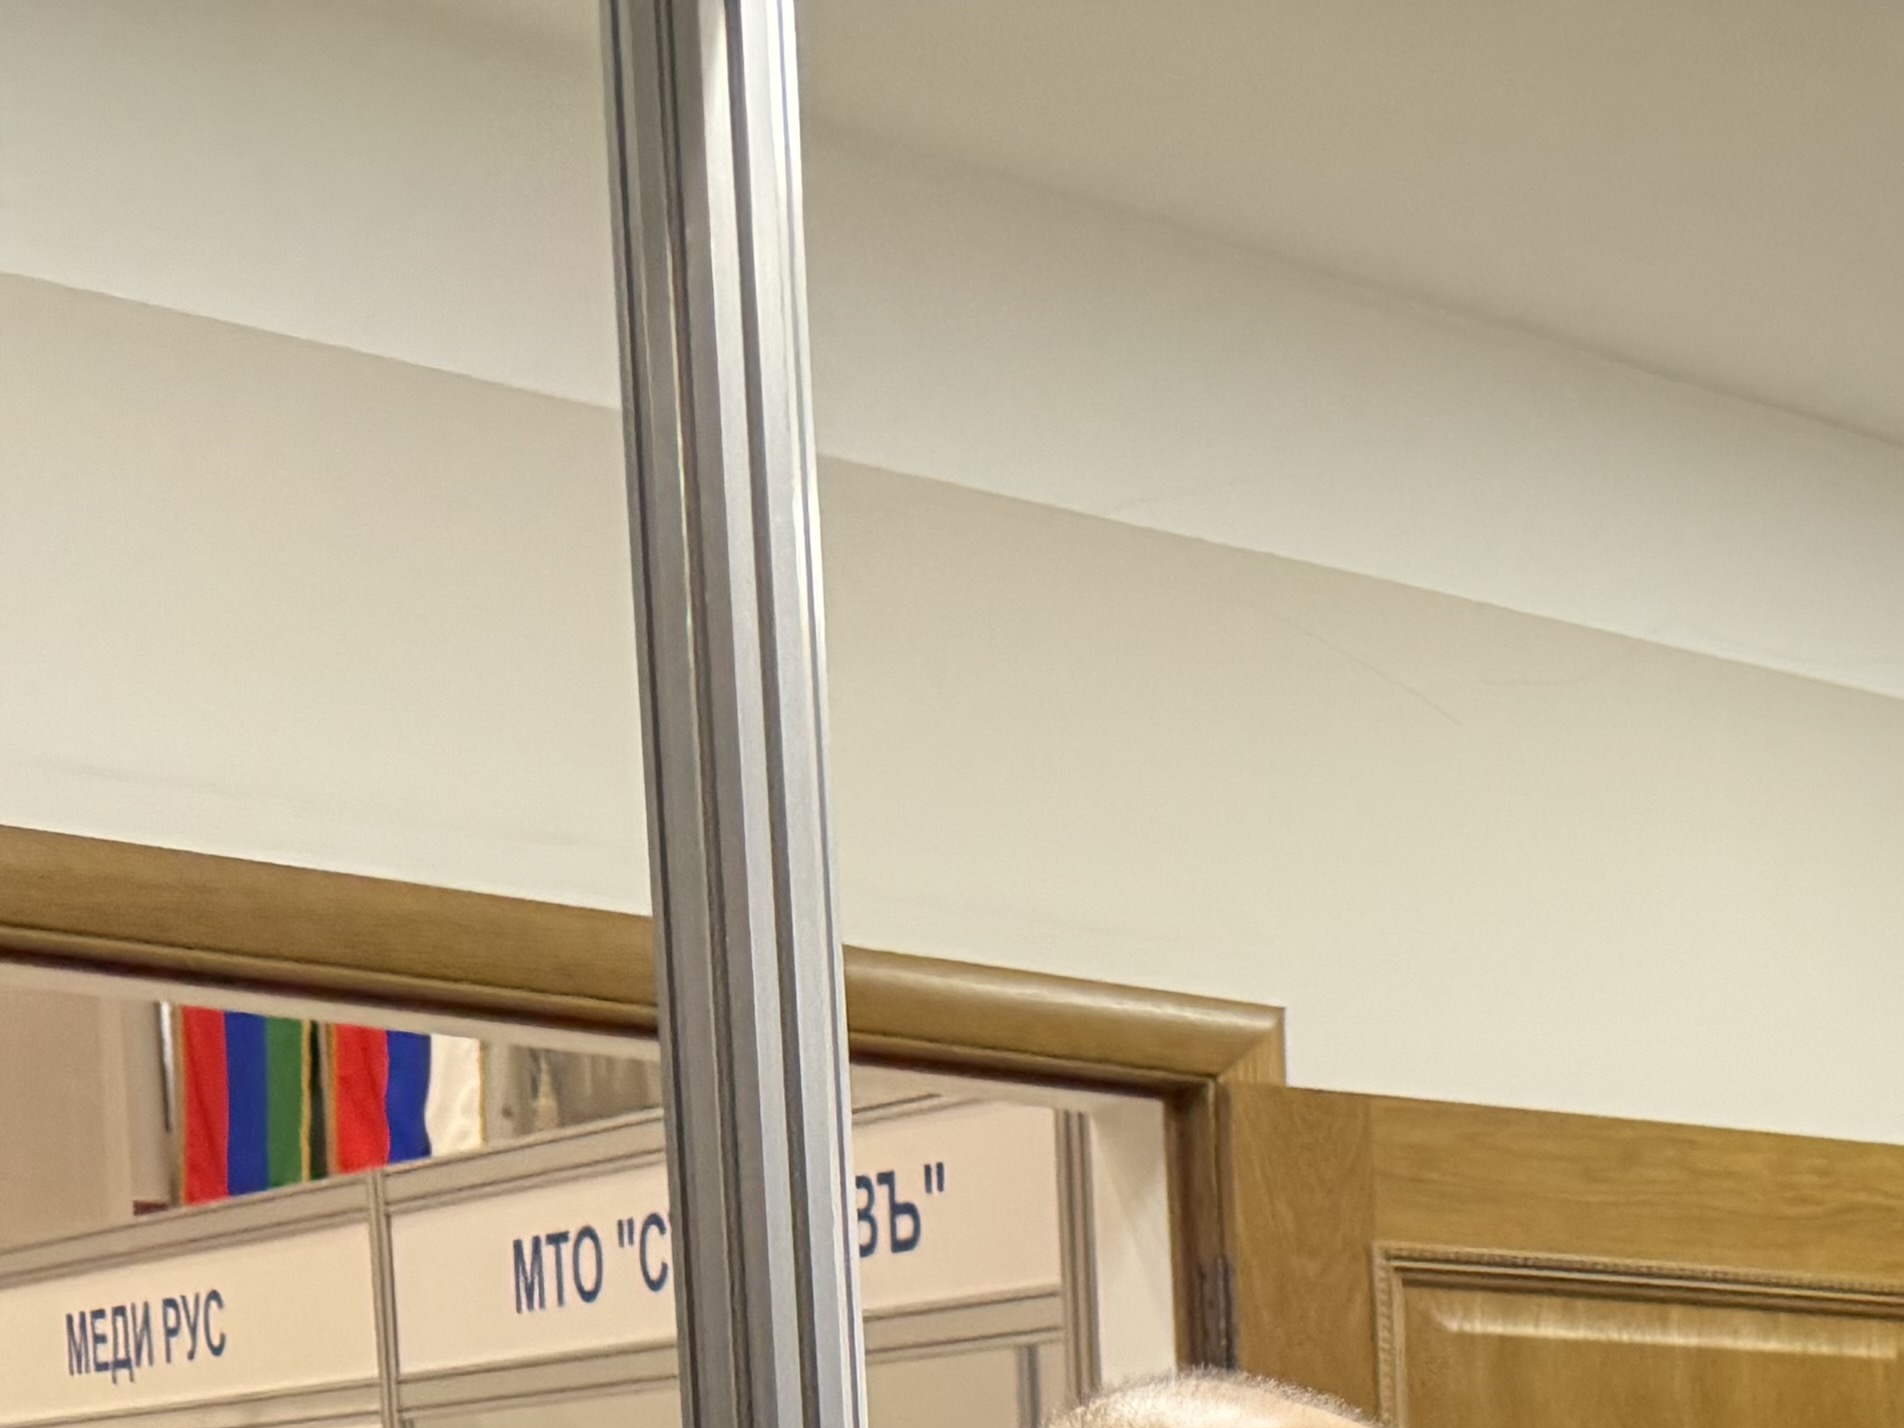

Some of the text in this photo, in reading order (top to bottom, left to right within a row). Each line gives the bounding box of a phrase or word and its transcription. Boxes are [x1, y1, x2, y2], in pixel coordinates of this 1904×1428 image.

[513, 1225, 604, 1315] МТО
[65, 1288, 227, 1385] МЕДИ РУС
